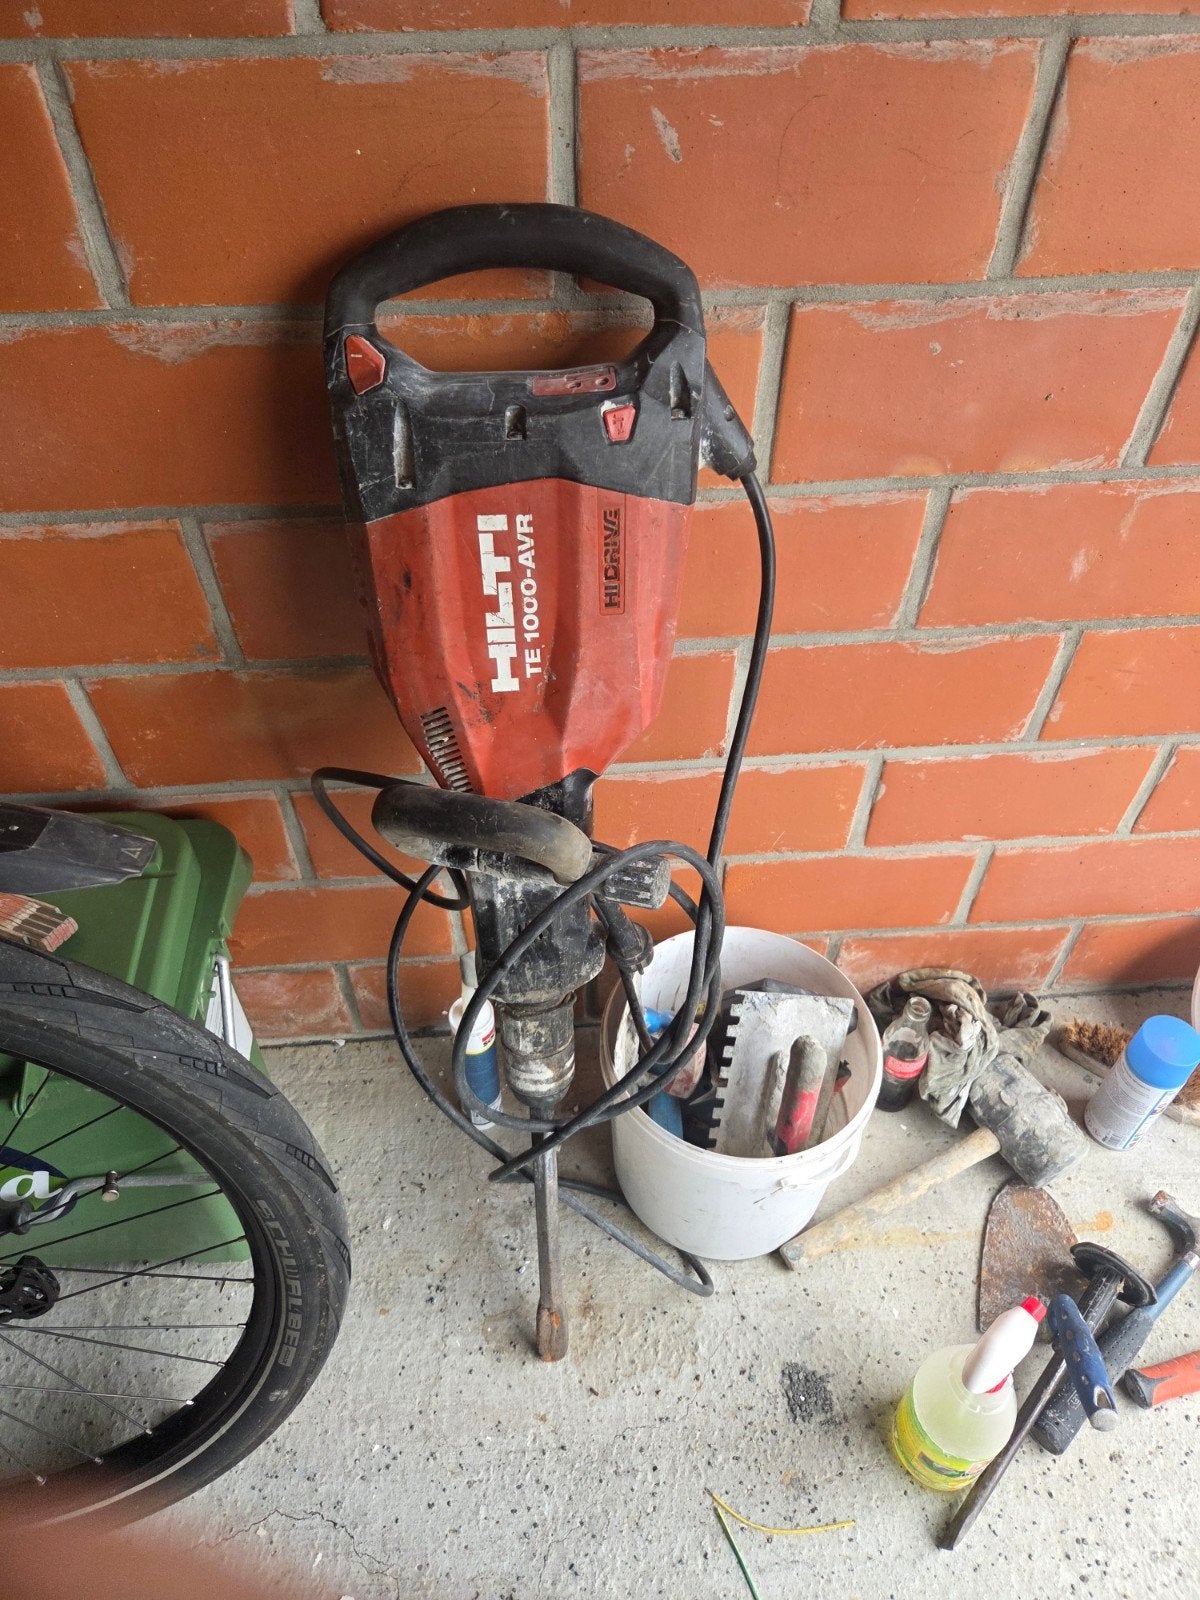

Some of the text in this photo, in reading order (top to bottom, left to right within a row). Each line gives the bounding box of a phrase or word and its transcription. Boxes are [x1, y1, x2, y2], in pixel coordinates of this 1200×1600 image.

[477, 514, 520, 693] HILTI
[515, 513, 542, 679] TE 1000-AVR
[256, 1199, 303, 1348] SCHWALBE
